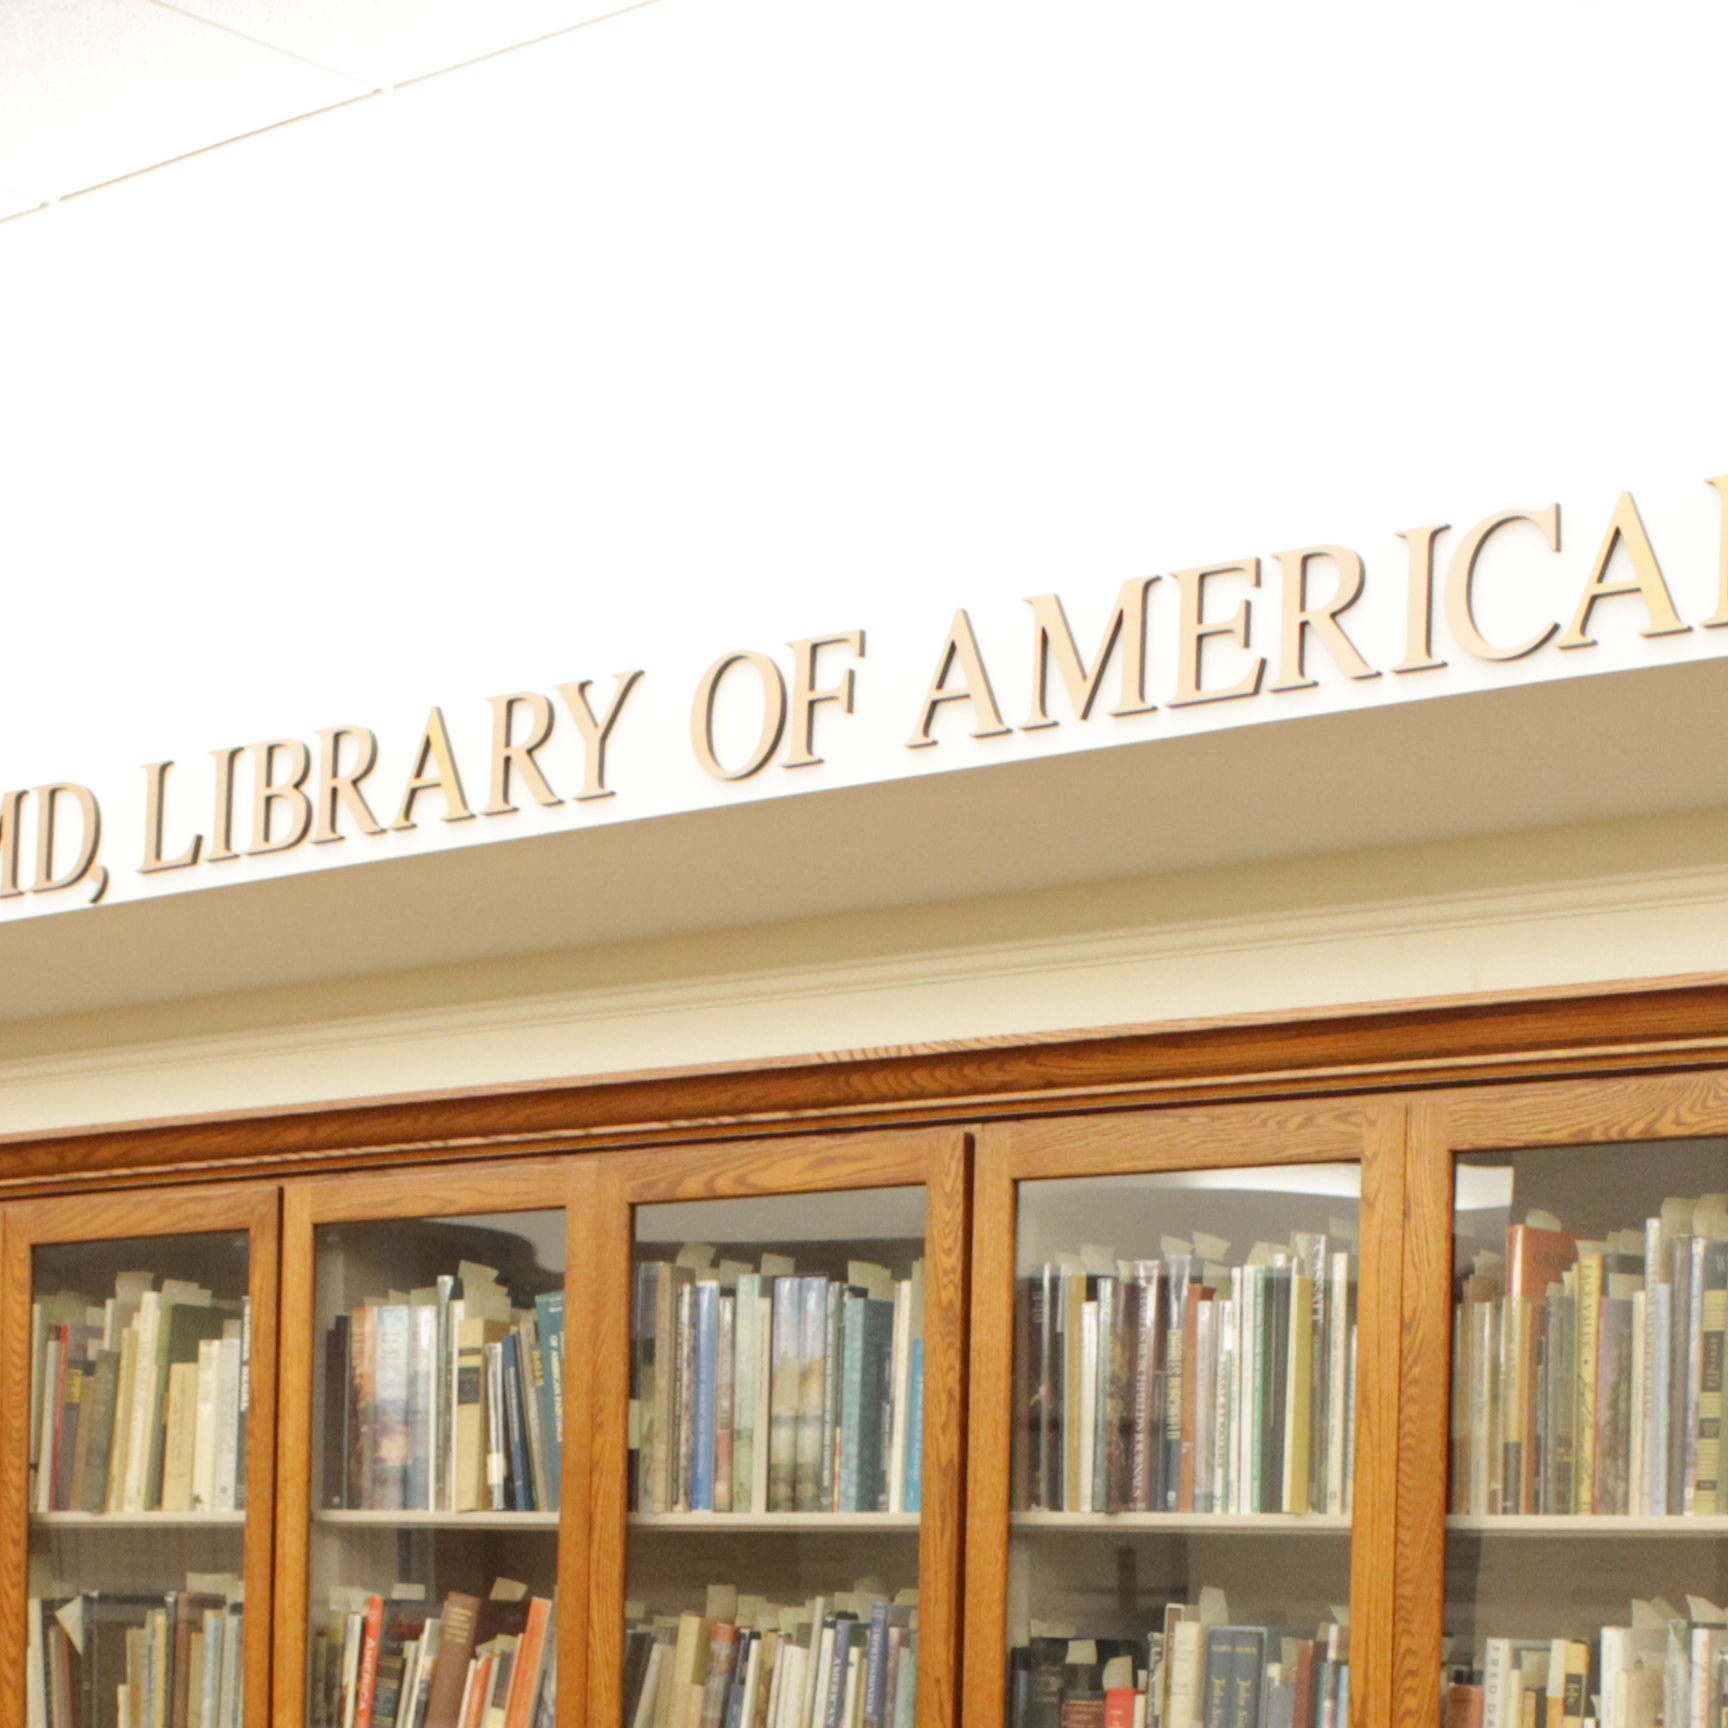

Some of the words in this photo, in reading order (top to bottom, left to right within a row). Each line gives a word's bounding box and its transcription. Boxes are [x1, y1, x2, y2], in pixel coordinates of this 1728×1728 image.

[136, 669, 646, 877] LIBRARY
[691, 629, 866, 785] OF
[1582, 1264, 1593, 1299] FACE
[1582, 1303, 1593, 1348] VALUE
[1167, 1329, 1182, 1375] CHARLES
[1133, 1434, 1145, 1497] JOURNALS
[357, 1636, 376, 1712] AMERICA
[826, 1655, 843, 1726] AMERICAN
[865, 1627, 881, 1716] IMPRESSIONISM
[1212, 1678, 1226, 1705] John
[1237, 1679, 1251, 1706] John
[1487, 1645, 1500, 1695] FRED
